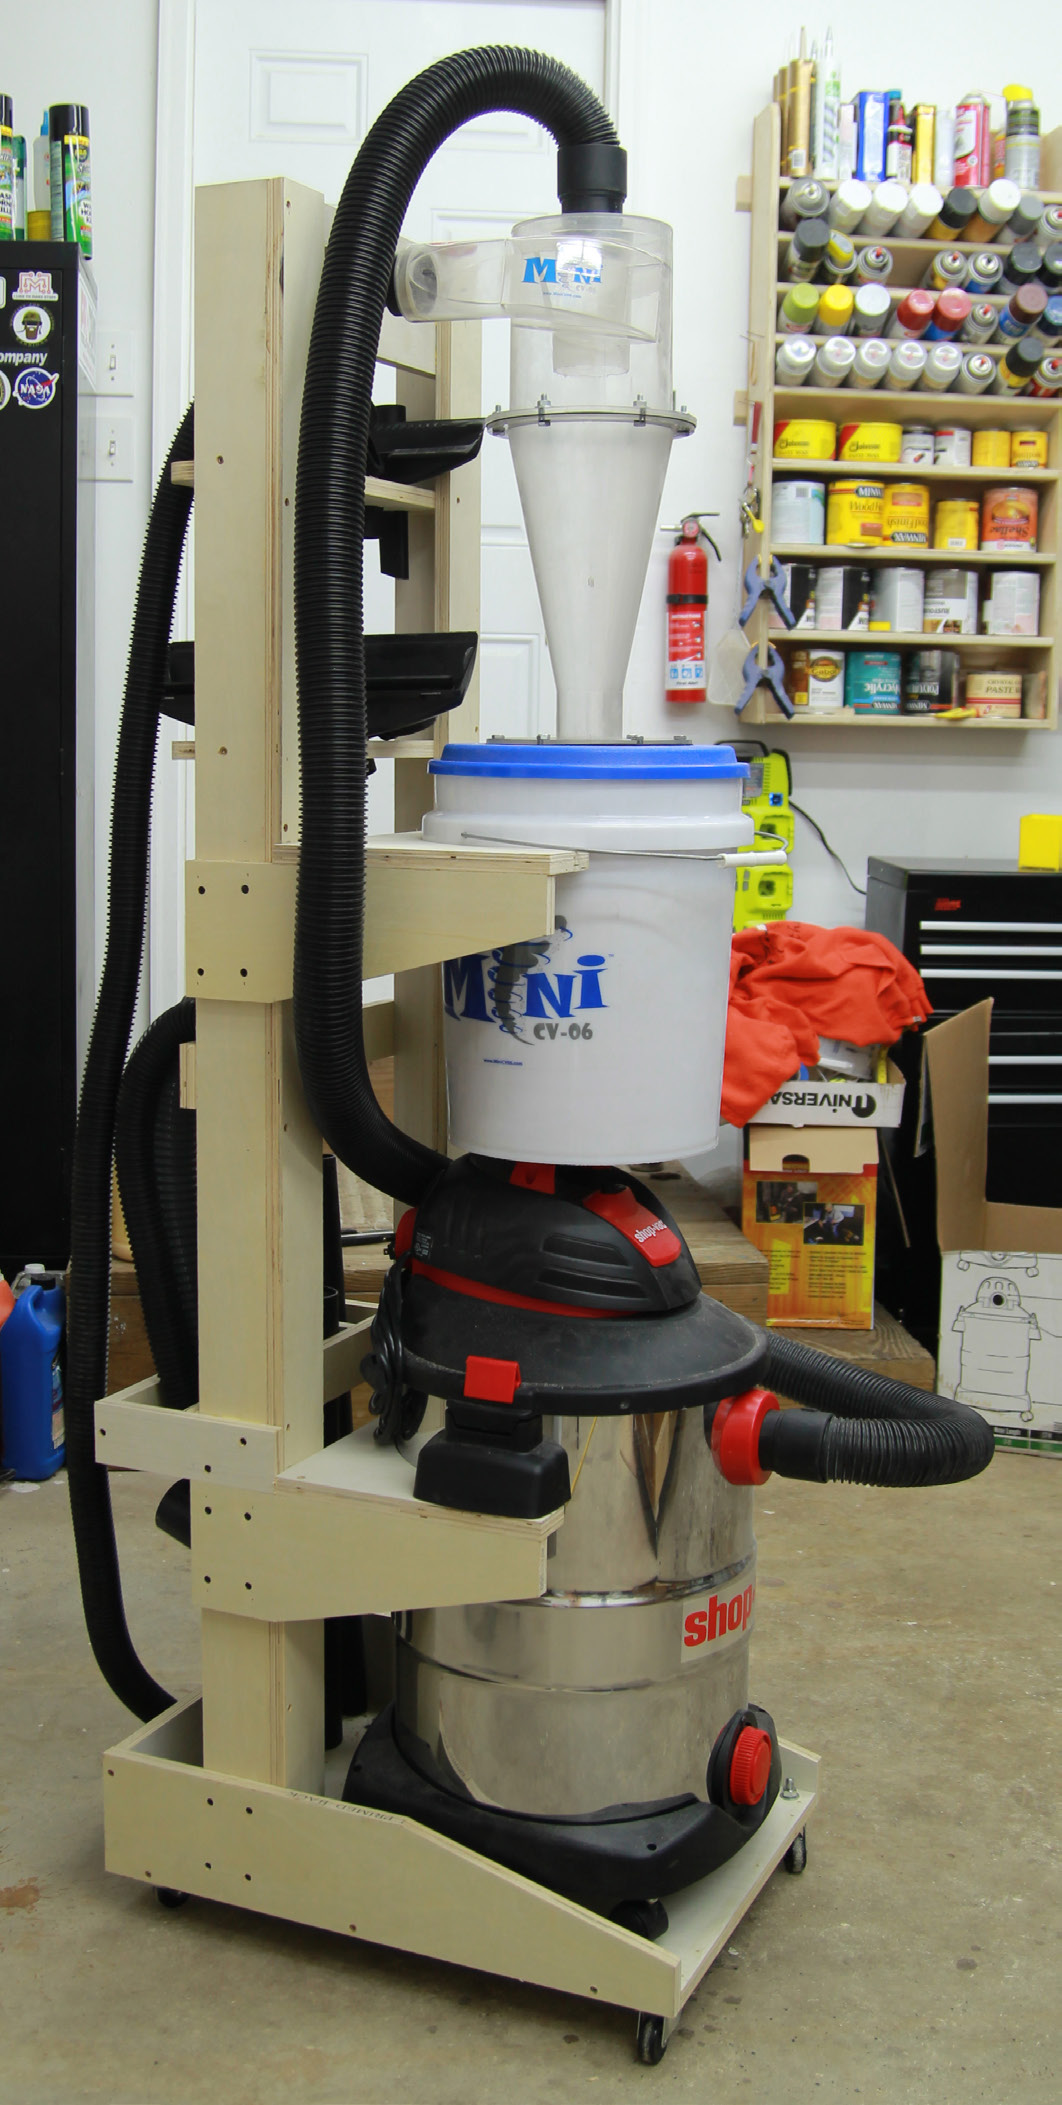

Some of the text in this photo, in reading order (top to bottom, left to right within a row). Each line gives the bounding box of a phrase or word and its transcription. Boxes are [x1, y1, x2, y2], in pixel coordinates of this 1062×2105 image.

[20, 384, 51, 396] NASA
[533, 1023, 593, 1040] CV-06
[634, 1219, 667, 1243] shop-vac
